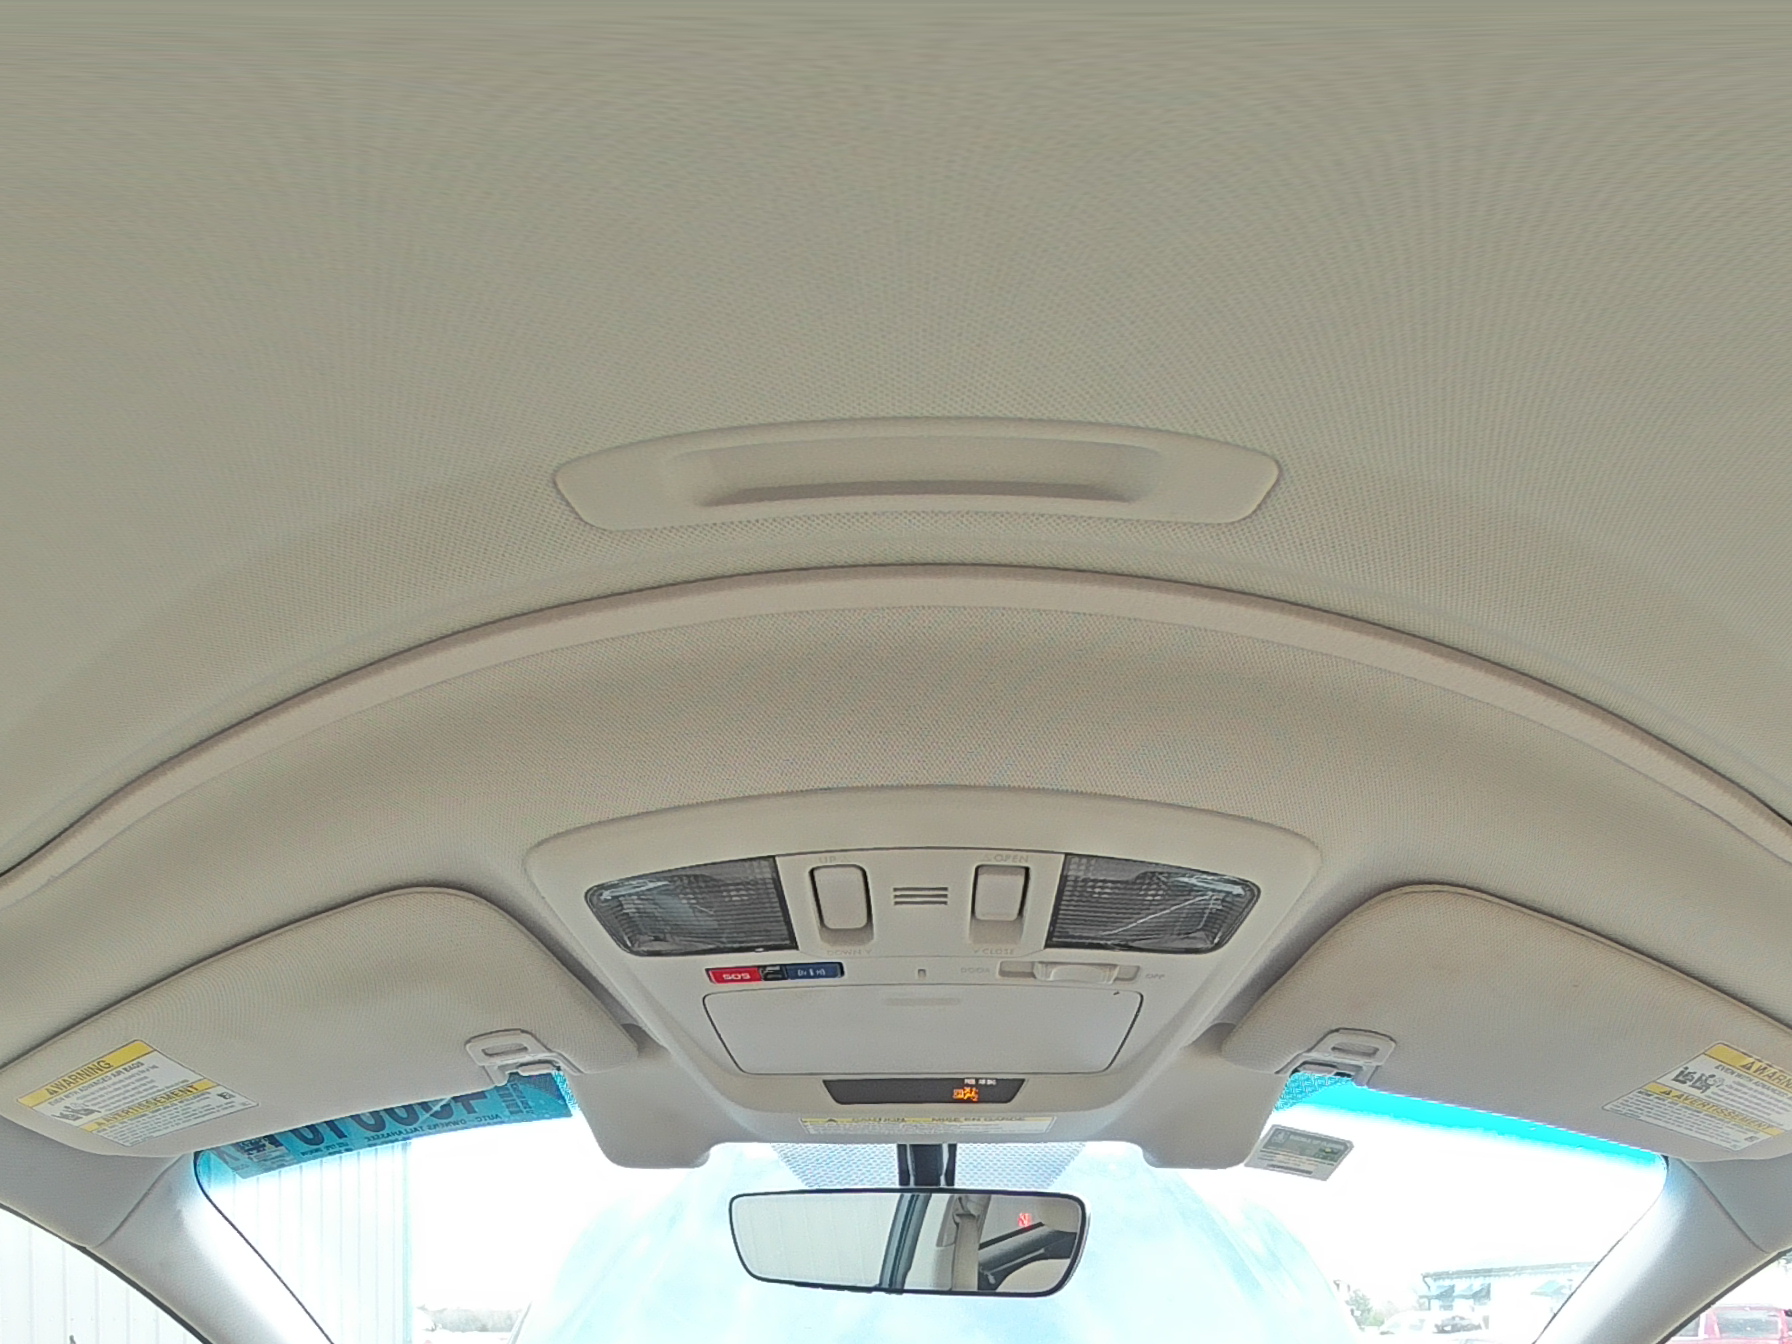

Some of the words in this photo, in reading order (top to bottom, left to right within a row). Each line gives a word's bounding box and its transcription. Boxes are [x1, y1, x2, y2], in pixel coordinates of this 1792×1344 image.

[994, 855, 1029, 863] OPEN
[983, 948, 1015, 956] CLOSE
[54, 1059, 114, 1094] WARNING
[101, 1084, 201, 1128] AVERTISSEMENT
[1673, 1088, 1774, 1132] AVERTISSEMENT
